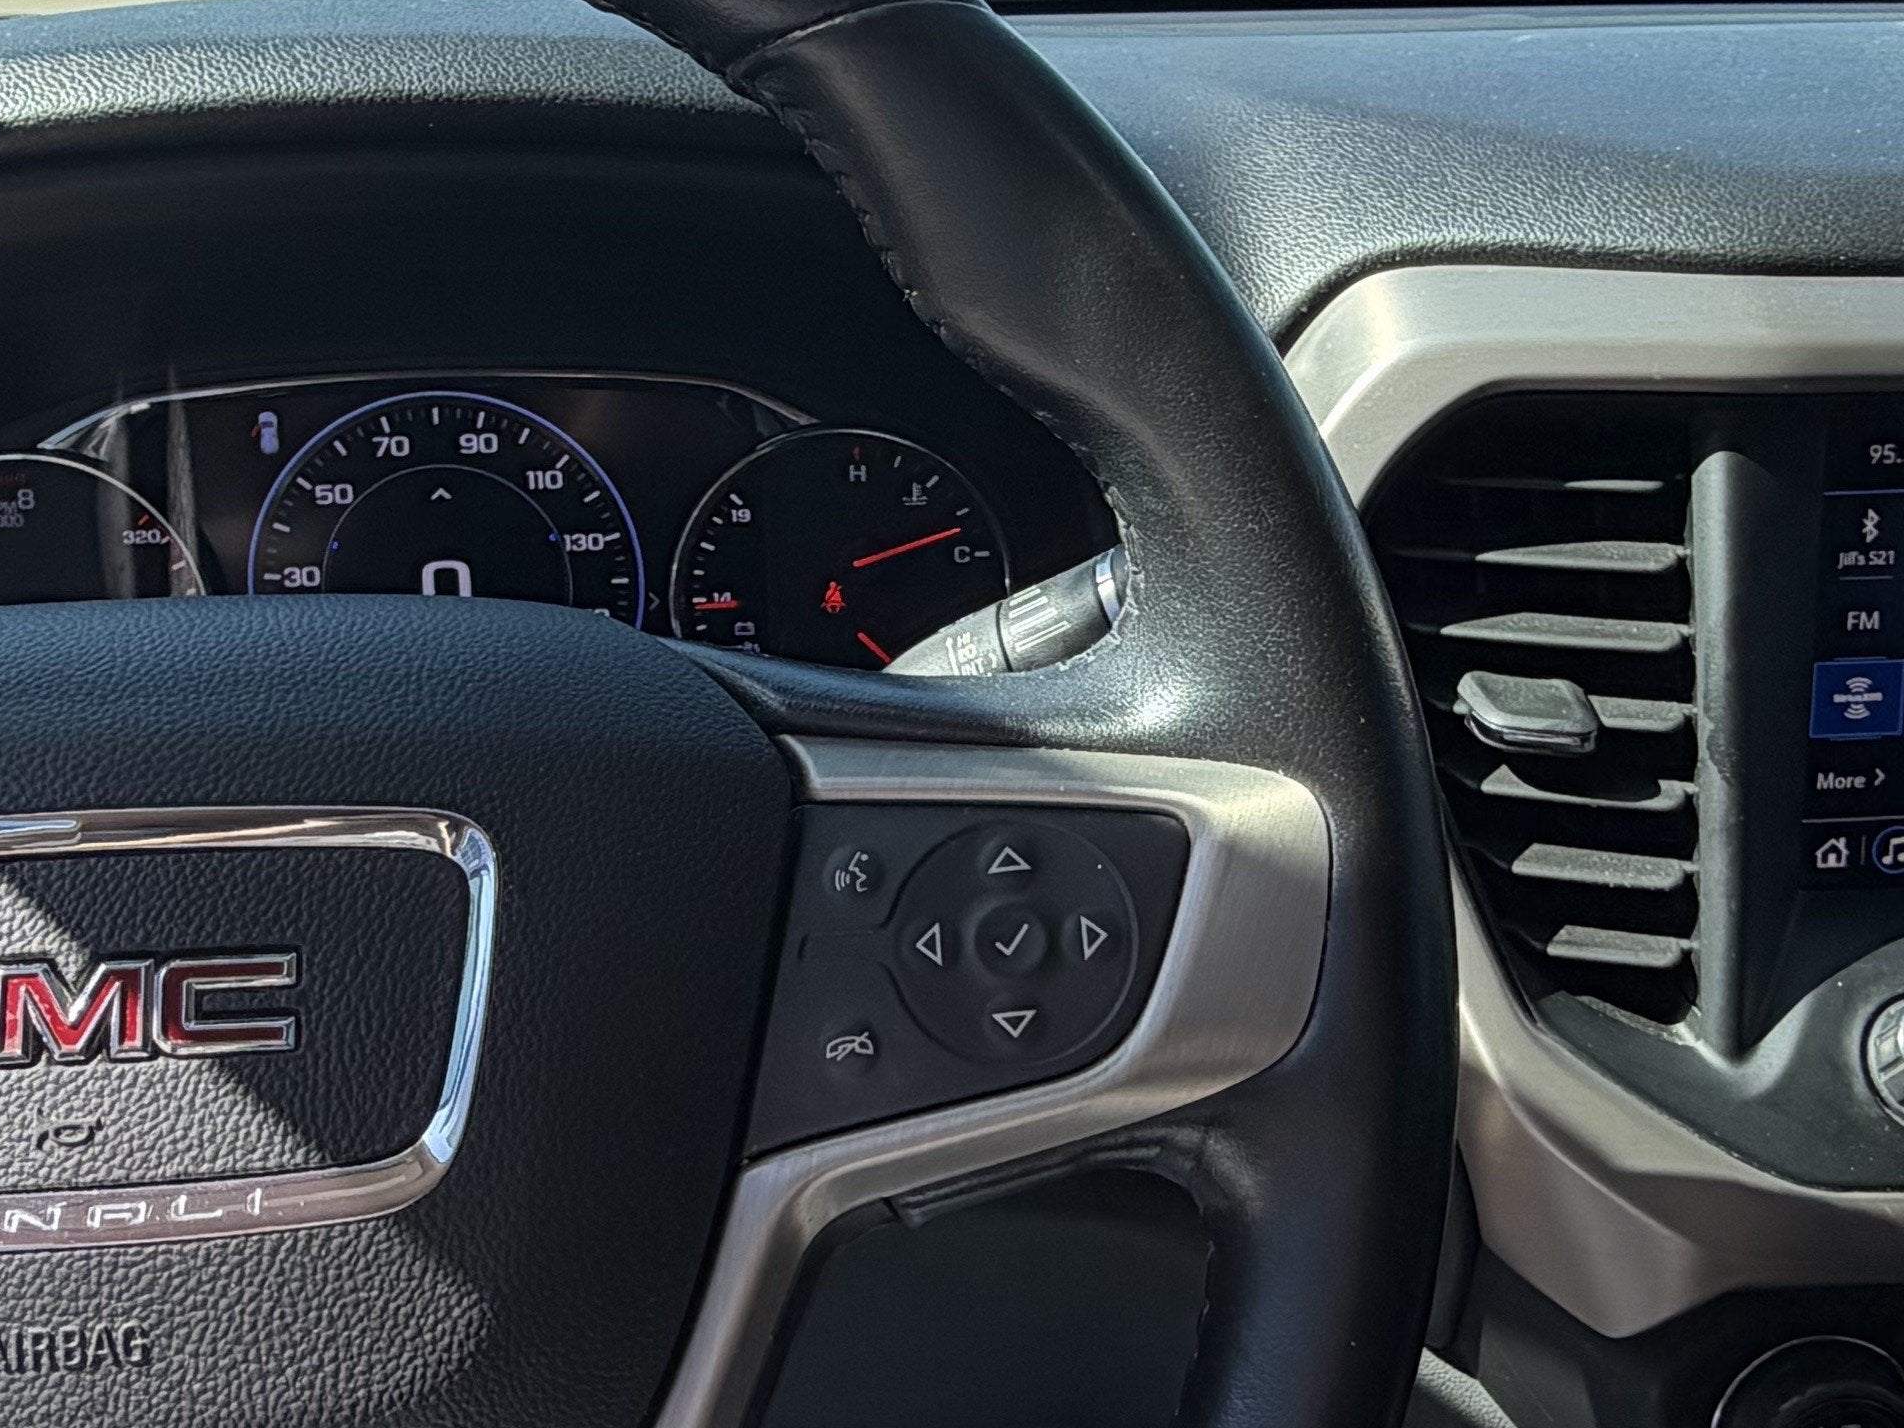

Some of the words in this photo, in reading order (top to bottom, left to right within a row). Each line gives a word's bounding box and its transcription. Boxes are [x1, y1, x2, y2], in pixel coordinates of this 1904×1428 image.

[370, 436, 411, 459] 70
[458, 432, 499, 455] 90
[526, 470, 564, 491] 110
[848, 464, 869, 483] H
[16, 488, 36, 511] 8
[314, 483, 354, 506] 50
[730, 508, 753, 524] 19
[122, 528, 162, 546] 320
[564, 532, 605, 553] 130
[952, 545, 972, 565] C
[1868, 550, 1896, 567] S21
[282, 565, 322, 588] 30
[1846, 611, 1881, 631] FM
[1815, 772, 1866, 790] More
